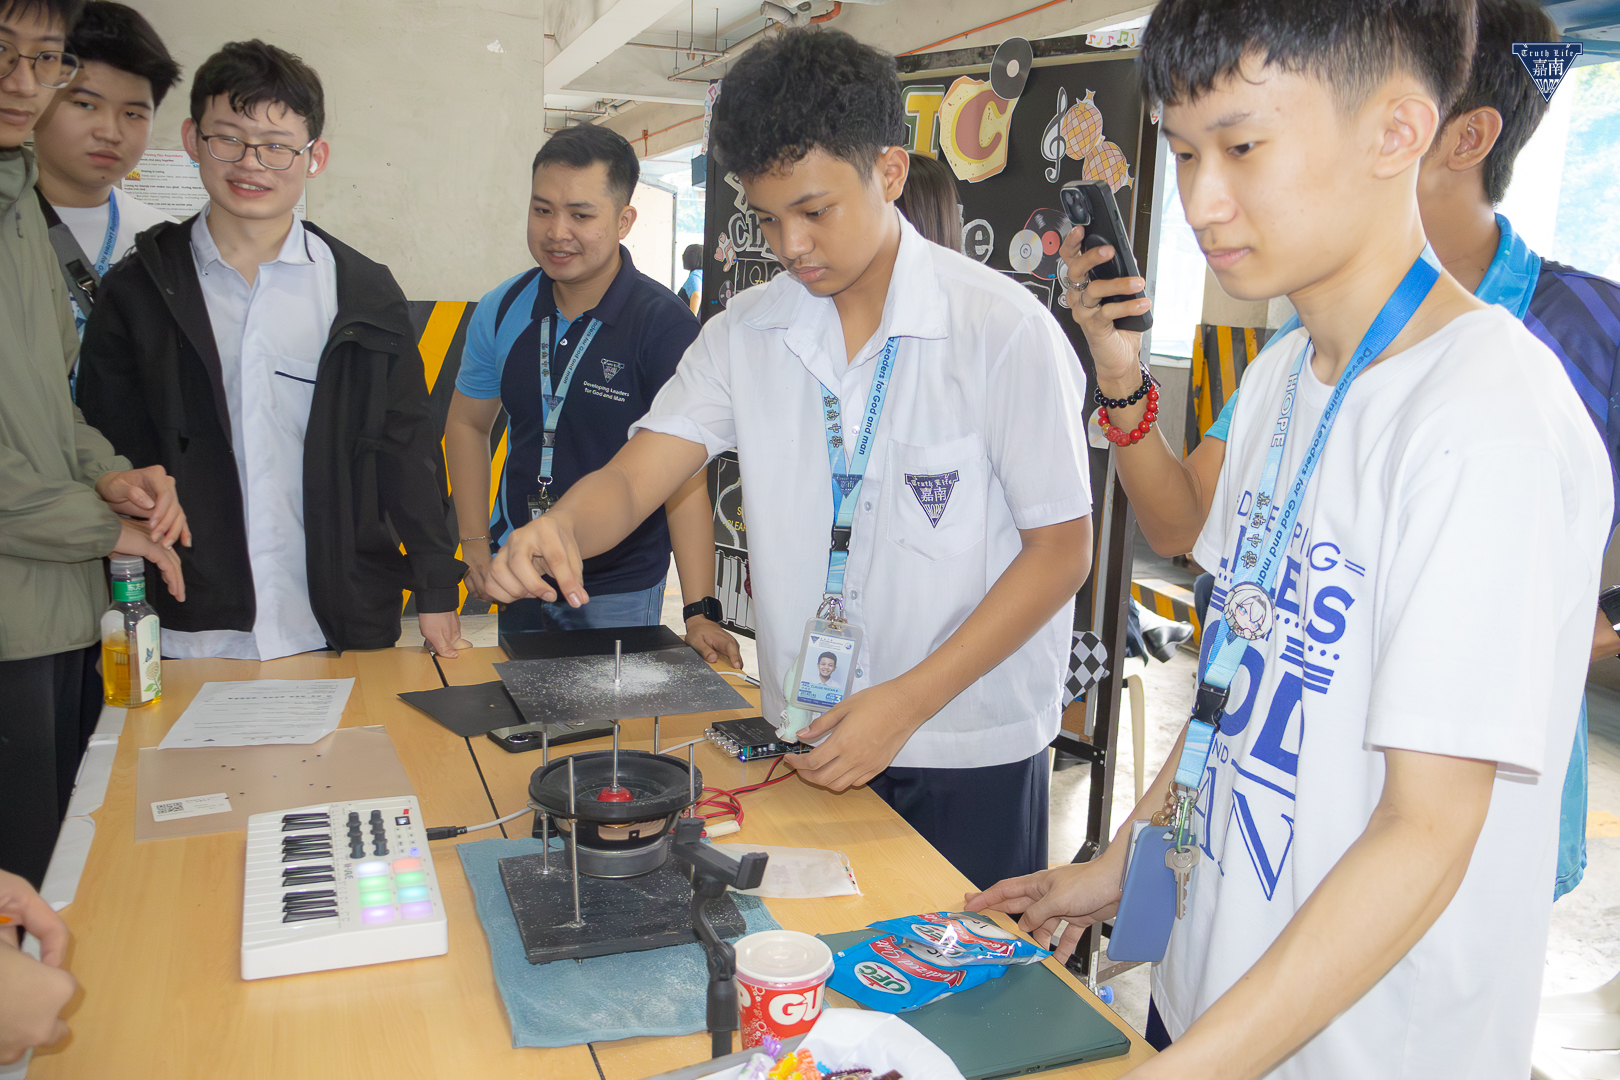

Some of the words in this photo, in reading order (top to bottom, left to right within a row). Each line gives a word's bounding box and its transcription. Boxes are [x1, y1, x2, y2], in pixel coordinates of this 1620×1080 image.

[575, 346, 584, 358] God
[878, 343, 894, 380] Leaders
[874, 380, 884, 394] for
[1323, 347, 1373, 421] Developing
[869, 395, 881, 415] God
[1271, 373, 1298, 448] HOPE
[863, 416, 874, 434] and
[858, 434, 870, 455] man
[1301, 424, 1327, 476] Leaders
[1293, 478, 1304, 497] for
[1280, 500, 1295, 529] God
[1269, 531, 1284, 558] and
[857, 963, 906, 993] UFC
[899, 958, 959, 984] Iodized
